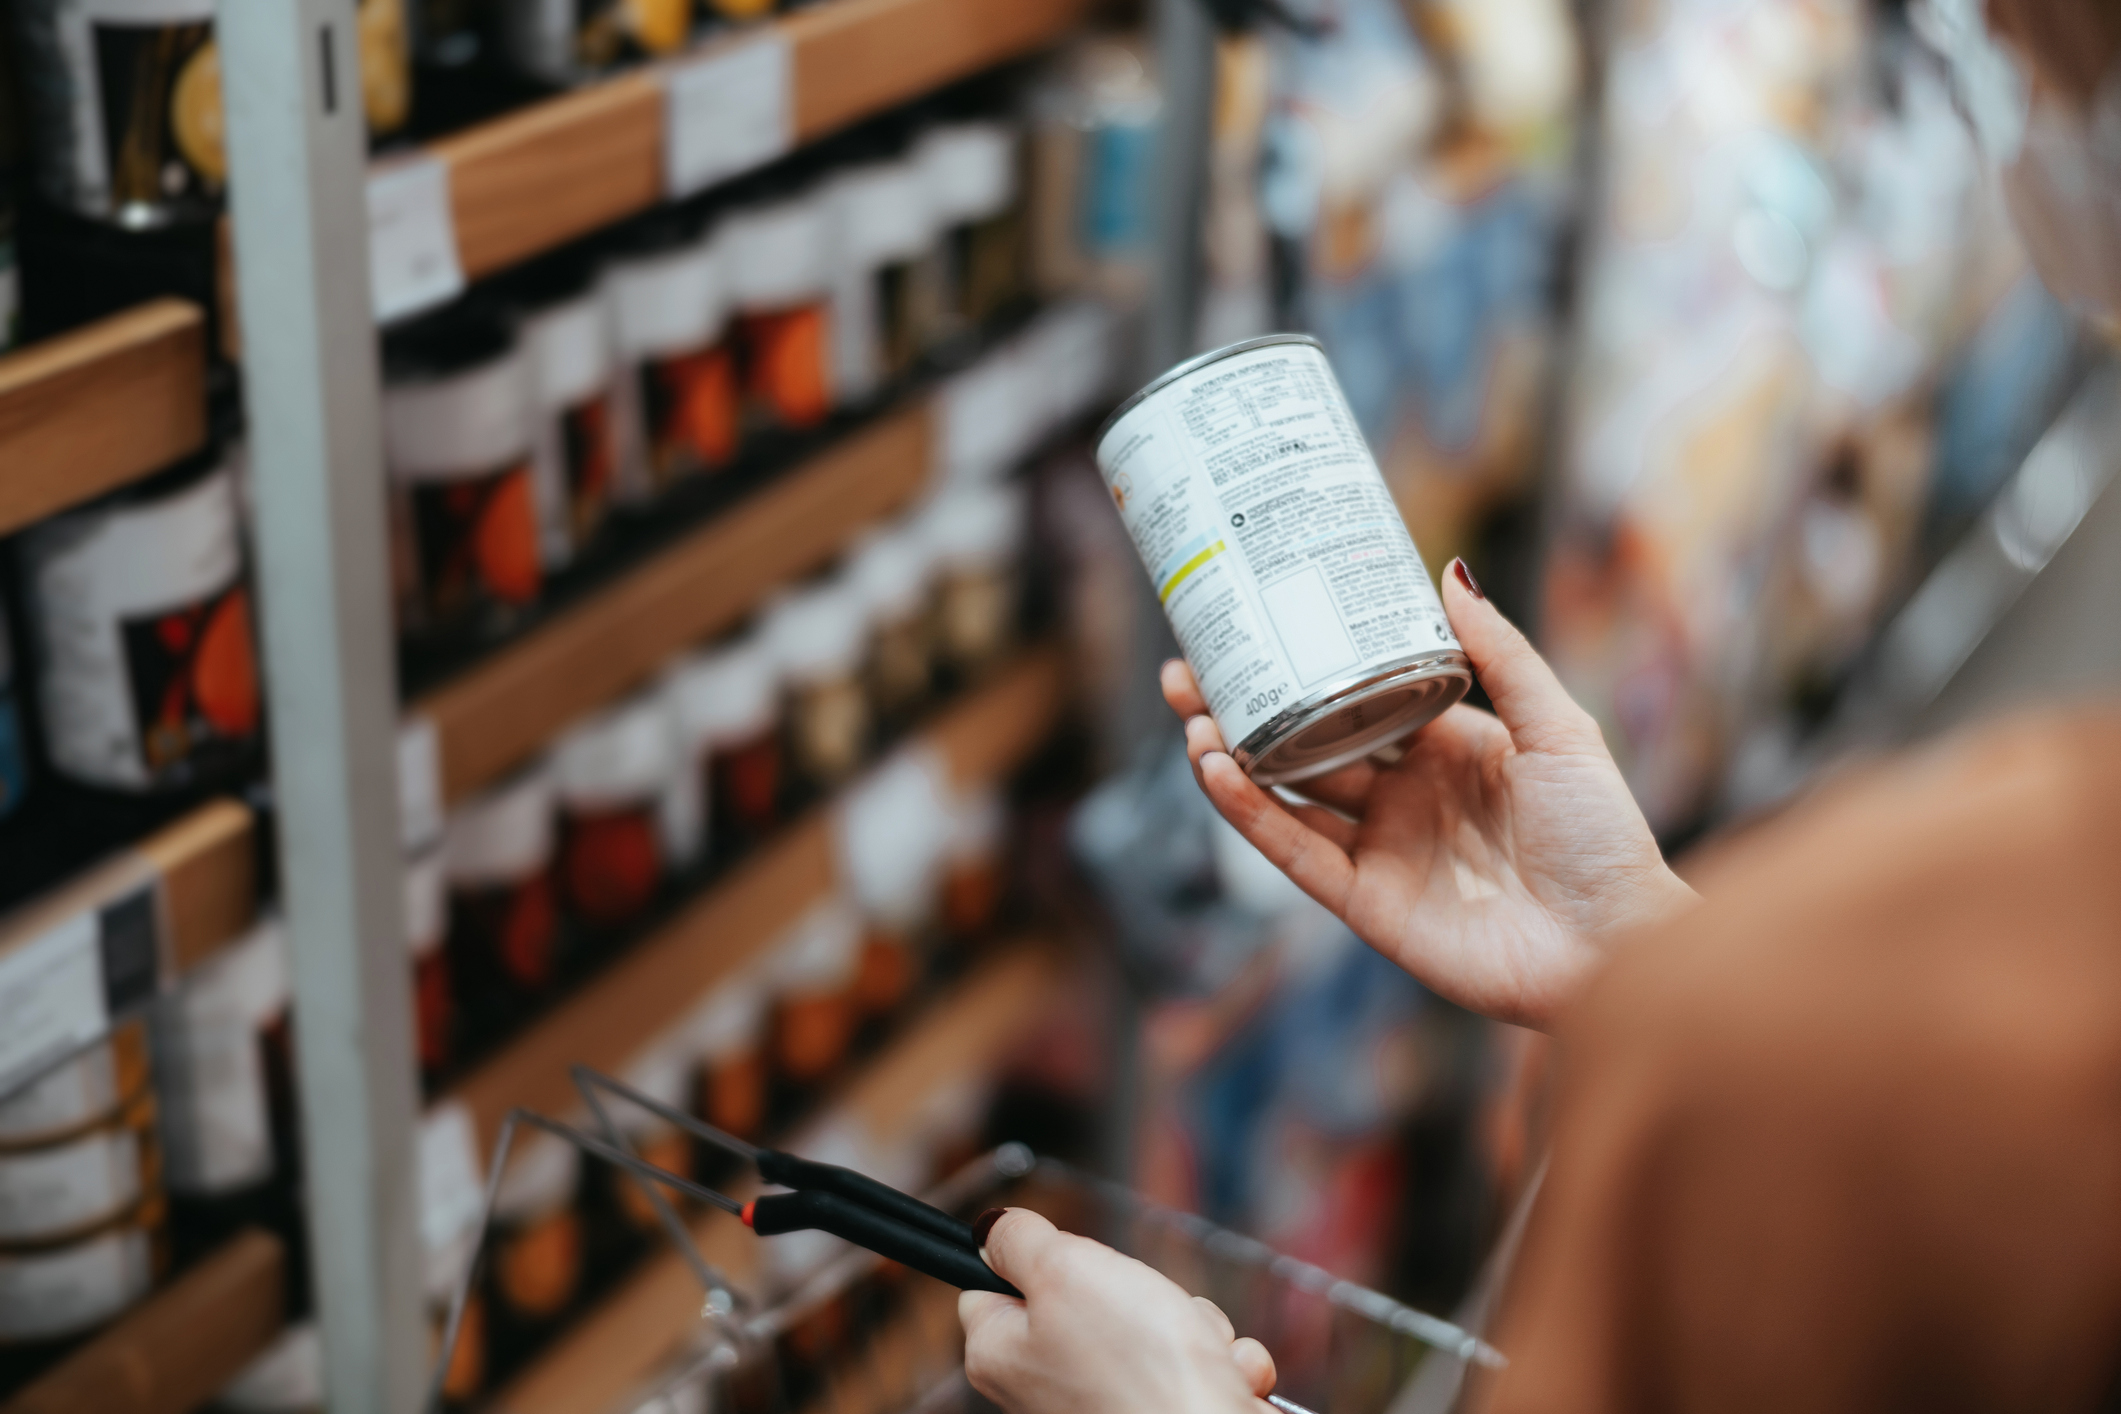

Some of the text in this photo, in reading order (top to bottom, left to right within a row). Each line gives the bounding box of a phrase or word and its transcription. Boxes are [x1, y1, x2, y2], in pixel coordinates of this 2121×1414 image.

[1190, 371, 1236, 395] NUTRITION
[1236, 357, 1290, 376] INFORMATION
[1232, 455, 1261, 472] BEFORE
[1252, 551, 1296, 576] INFORMATIE
[1348, 618, 1370, 631] Made
[1369, 616, 1377, 624] in
[1377, 612, 1390, 621] the
